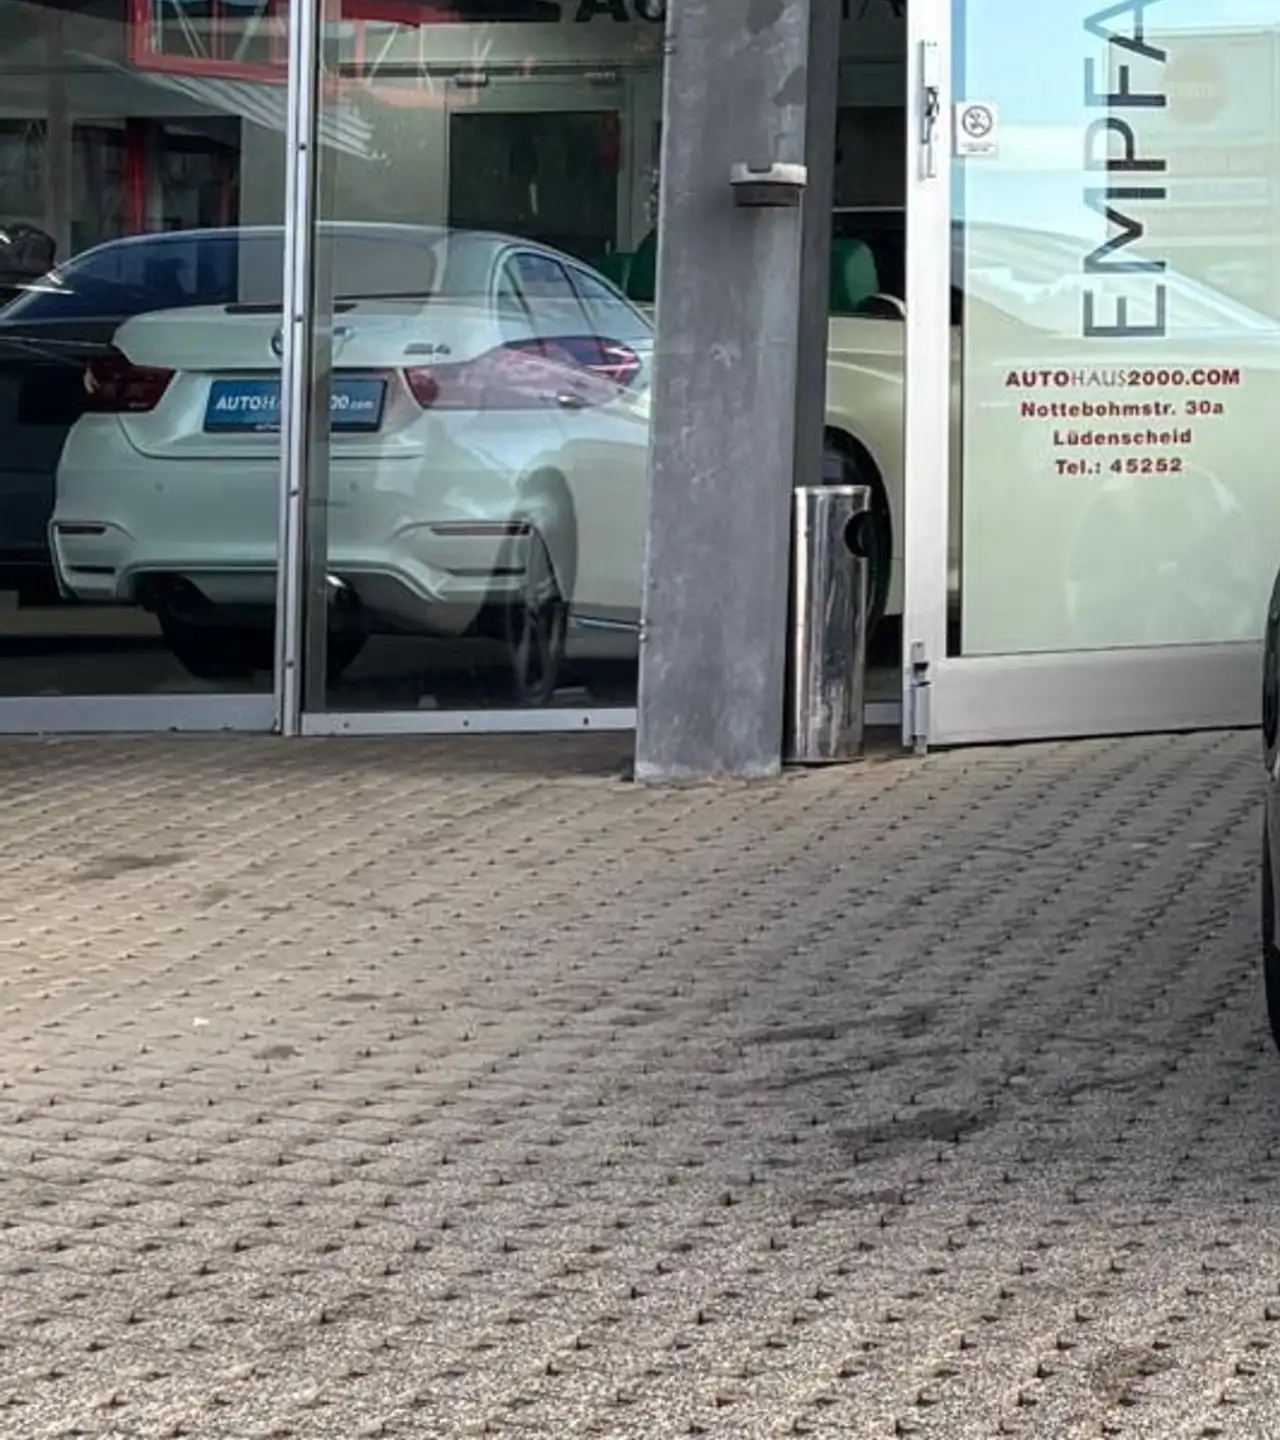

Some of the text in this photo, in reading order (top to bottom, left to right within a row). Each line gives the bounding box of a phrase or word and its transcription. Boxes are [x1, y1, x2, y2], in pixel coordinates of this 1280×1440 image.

[1005, 369, 1241, 388] AUTOHAUS2000.COM
[1020, 400, 1224, 418] Nottebohmstr. 30a
[1053, 428, 1193, 446] Lüdenscheid
[1055, 457, 1182, 475] Tel.: 45252
